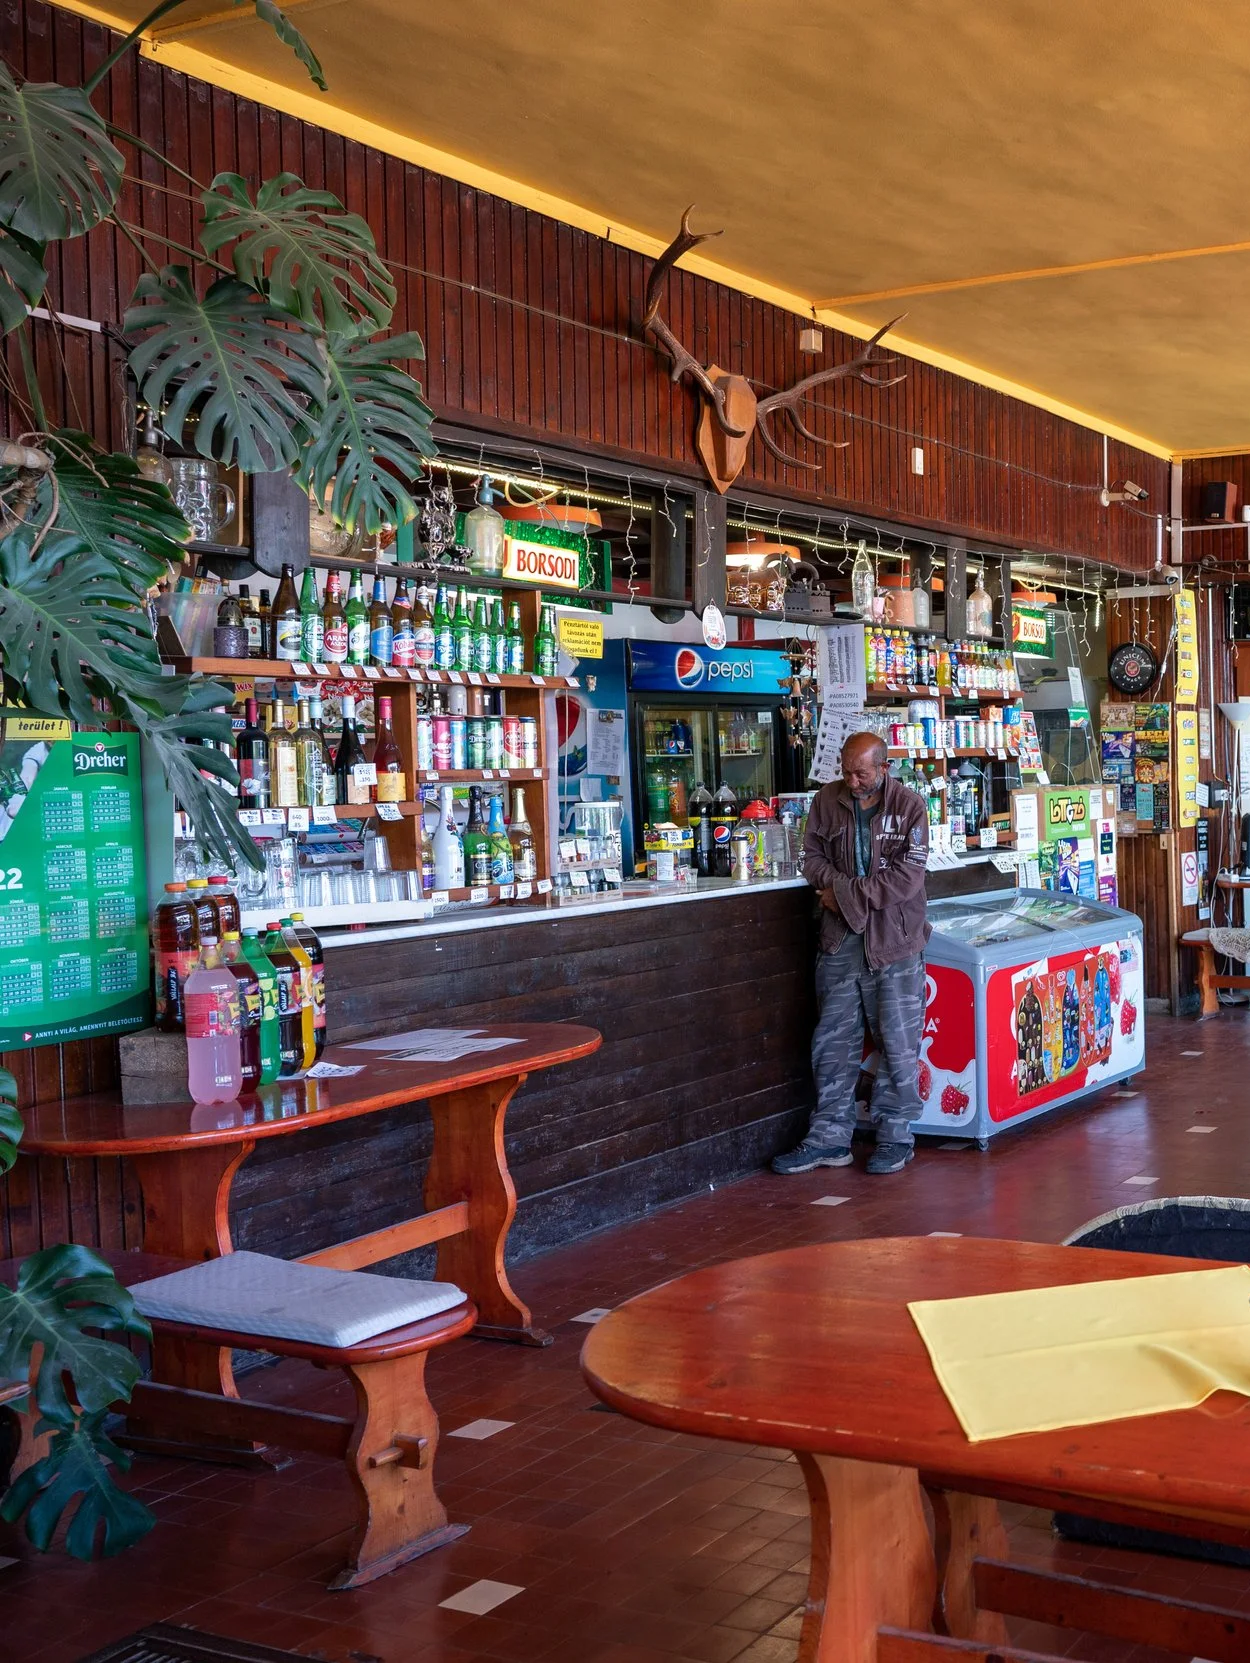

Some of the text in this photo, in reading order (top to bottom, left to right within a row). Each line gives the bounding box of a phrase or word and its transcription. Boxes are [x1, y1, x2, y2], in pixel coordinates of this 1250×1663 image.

[516, 549, 576, 581] BORSODI
[563, 645, 589, 654] ogadunk
[1119, 652, 1148, 667] UNICUM
[707, 659, 754, 681] pepsi
[18, 720, 56, 731] terület
[73, 751, 127, 771] Dreher
[35, 1031, 54, 1039] ANNYI
[79, 1021, 107, 1033] AMENNYIT
[108, 1015, 143, 1028] BELETÖLTESZ
